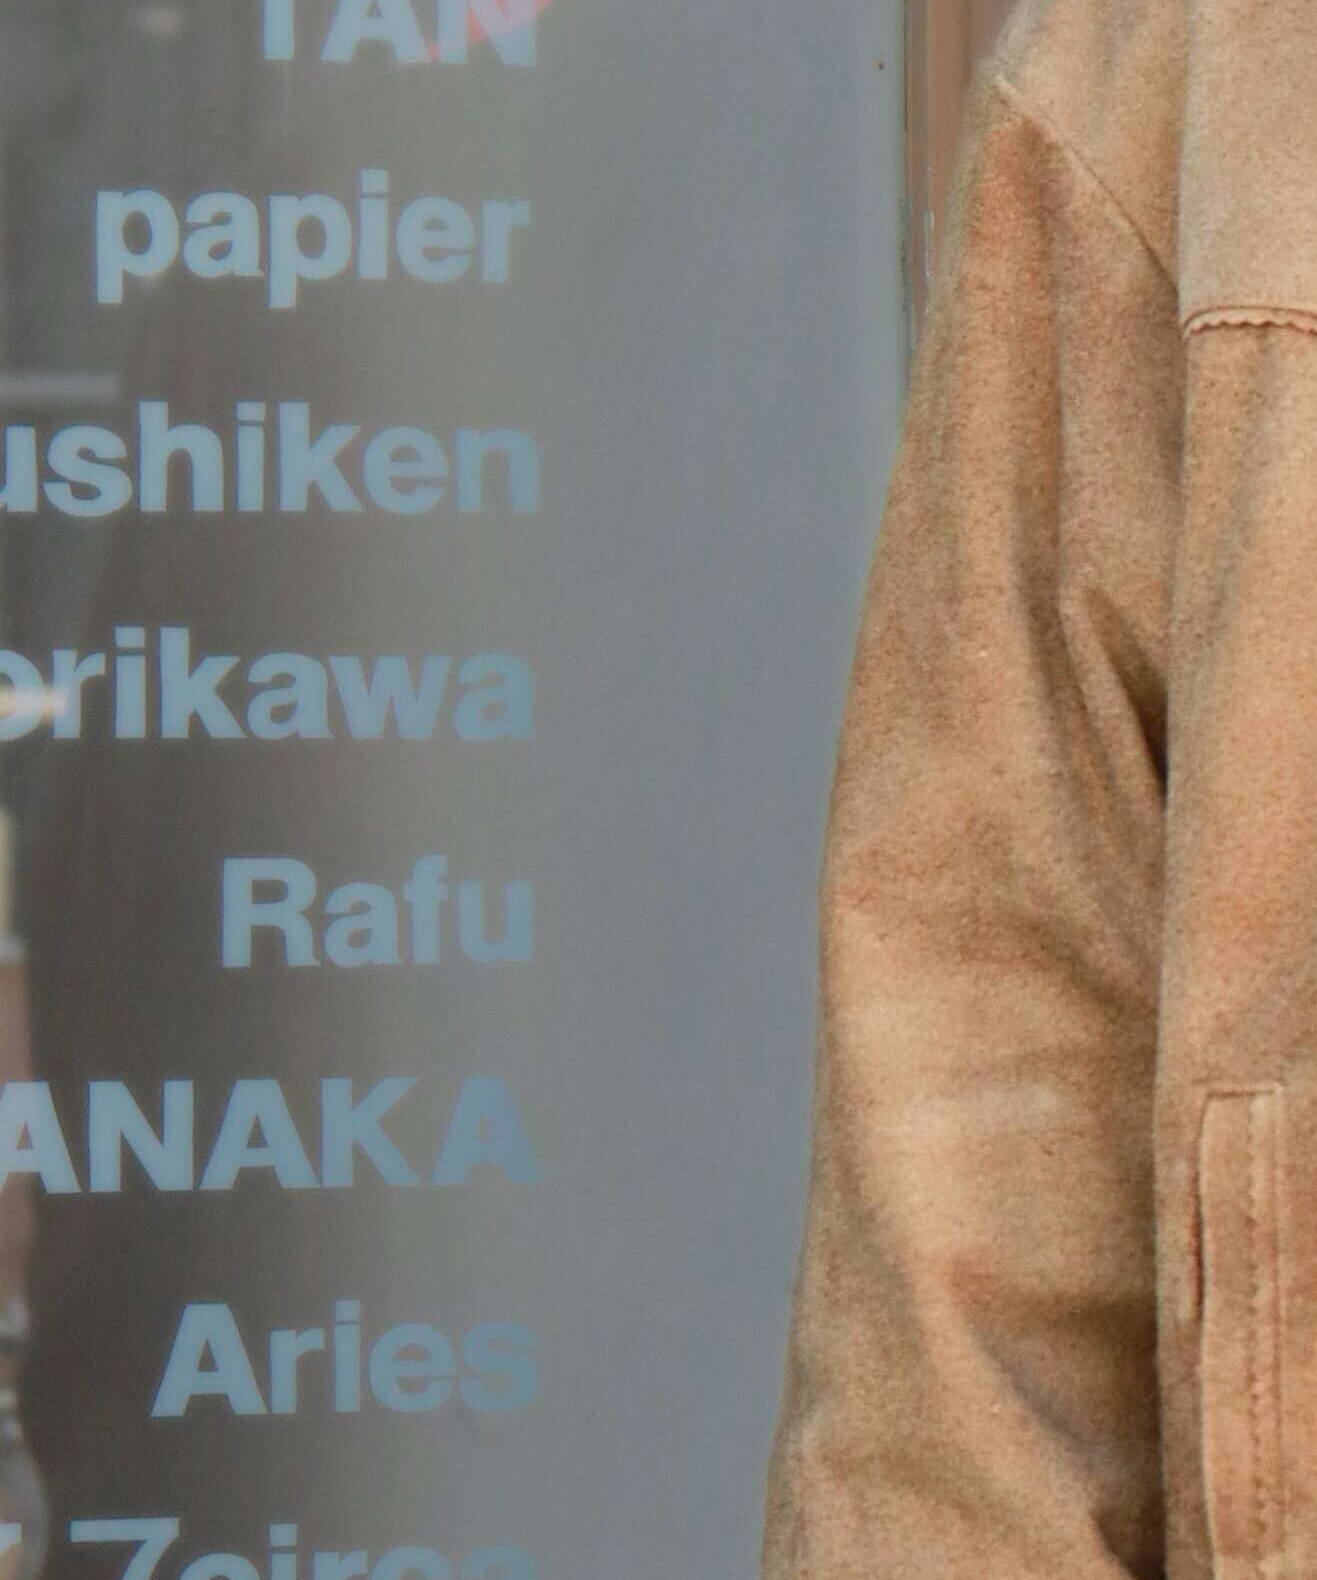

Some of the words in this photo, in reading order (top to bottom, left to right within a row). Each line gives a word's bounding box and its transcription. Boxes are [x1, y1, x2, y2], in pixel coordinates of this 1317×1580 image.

[95, 170, 530, 308] papier
[222, 855, 534, 968] Rafu
[151, 1300, 540, 1417] Aries
